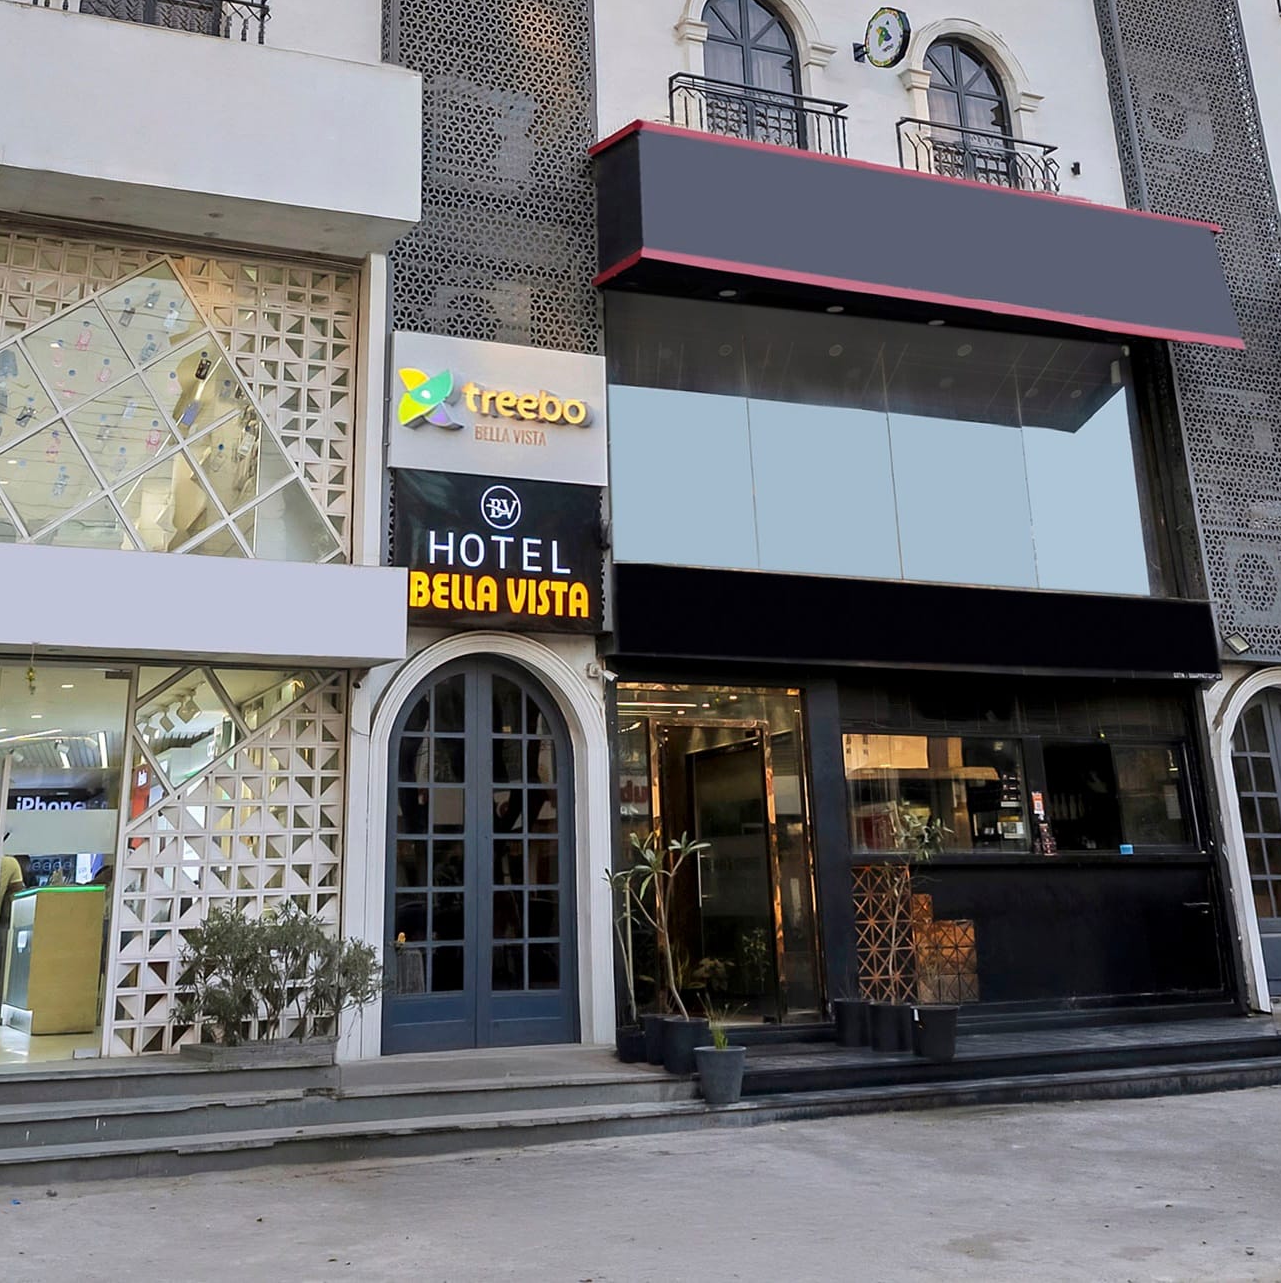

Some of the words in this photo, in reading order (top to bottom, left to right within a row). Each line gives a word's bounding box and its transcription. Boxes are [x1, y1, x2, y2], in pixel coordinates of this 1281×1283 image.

[462, 380, 589, 426] treebo
[475, 426, 510, 444] BELLA
[513, 429, 547, 447] VISTA
[429, 530, 571, 575] HOTEL
[409, 571, 498, 612] BELLA
[507, 578, 590, 618] VISTA
